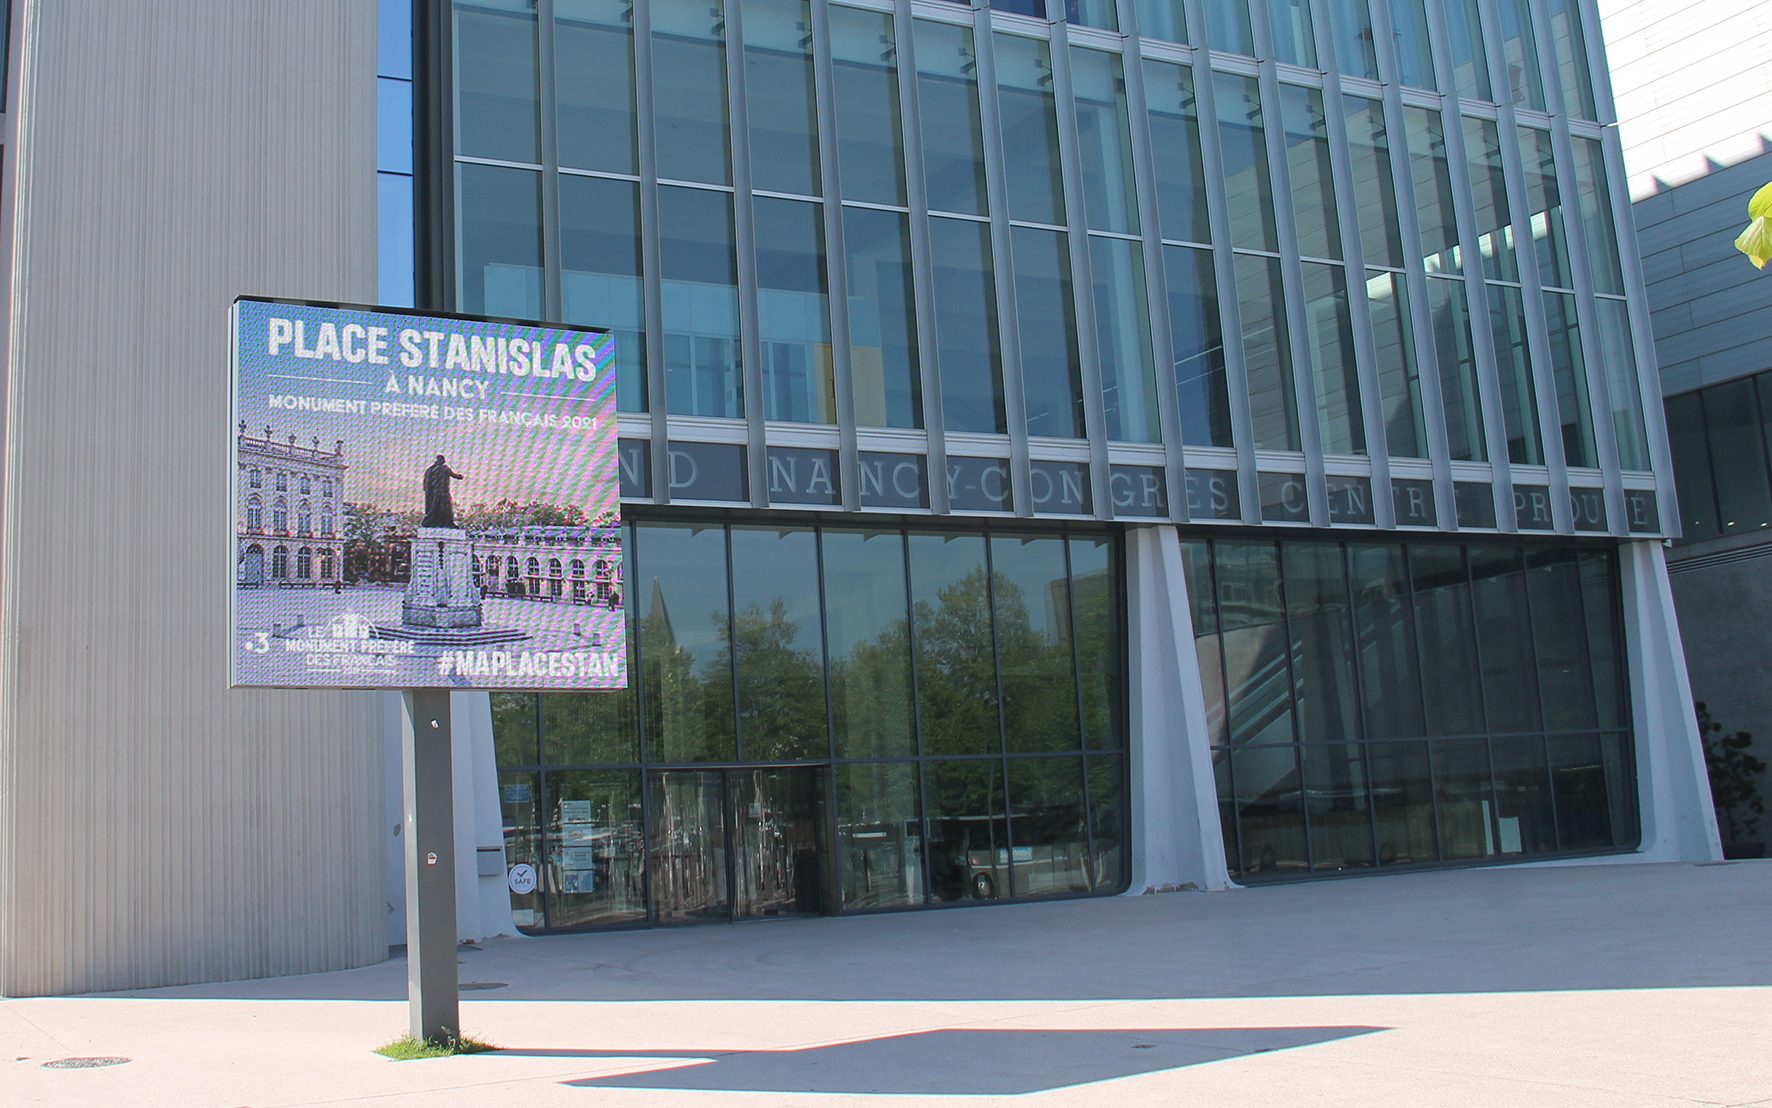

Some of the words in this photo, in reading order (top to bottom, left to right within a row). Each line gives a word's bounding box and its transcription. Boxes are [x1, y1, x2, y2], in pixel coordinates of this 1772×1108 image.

[268, 317, 390, 365] PLACE
[399, 328, 597, 382] STANISLAS
[385, 369, 401, 393] À
[407, 375, 489, 400] NANCY
[268, 394, 367, 415] MONUMENT
[444, 406, 474, 421] DES
[562, 415, 597, 430] 2021
[437, 650, 619, 676] #MAPLACESTAN
